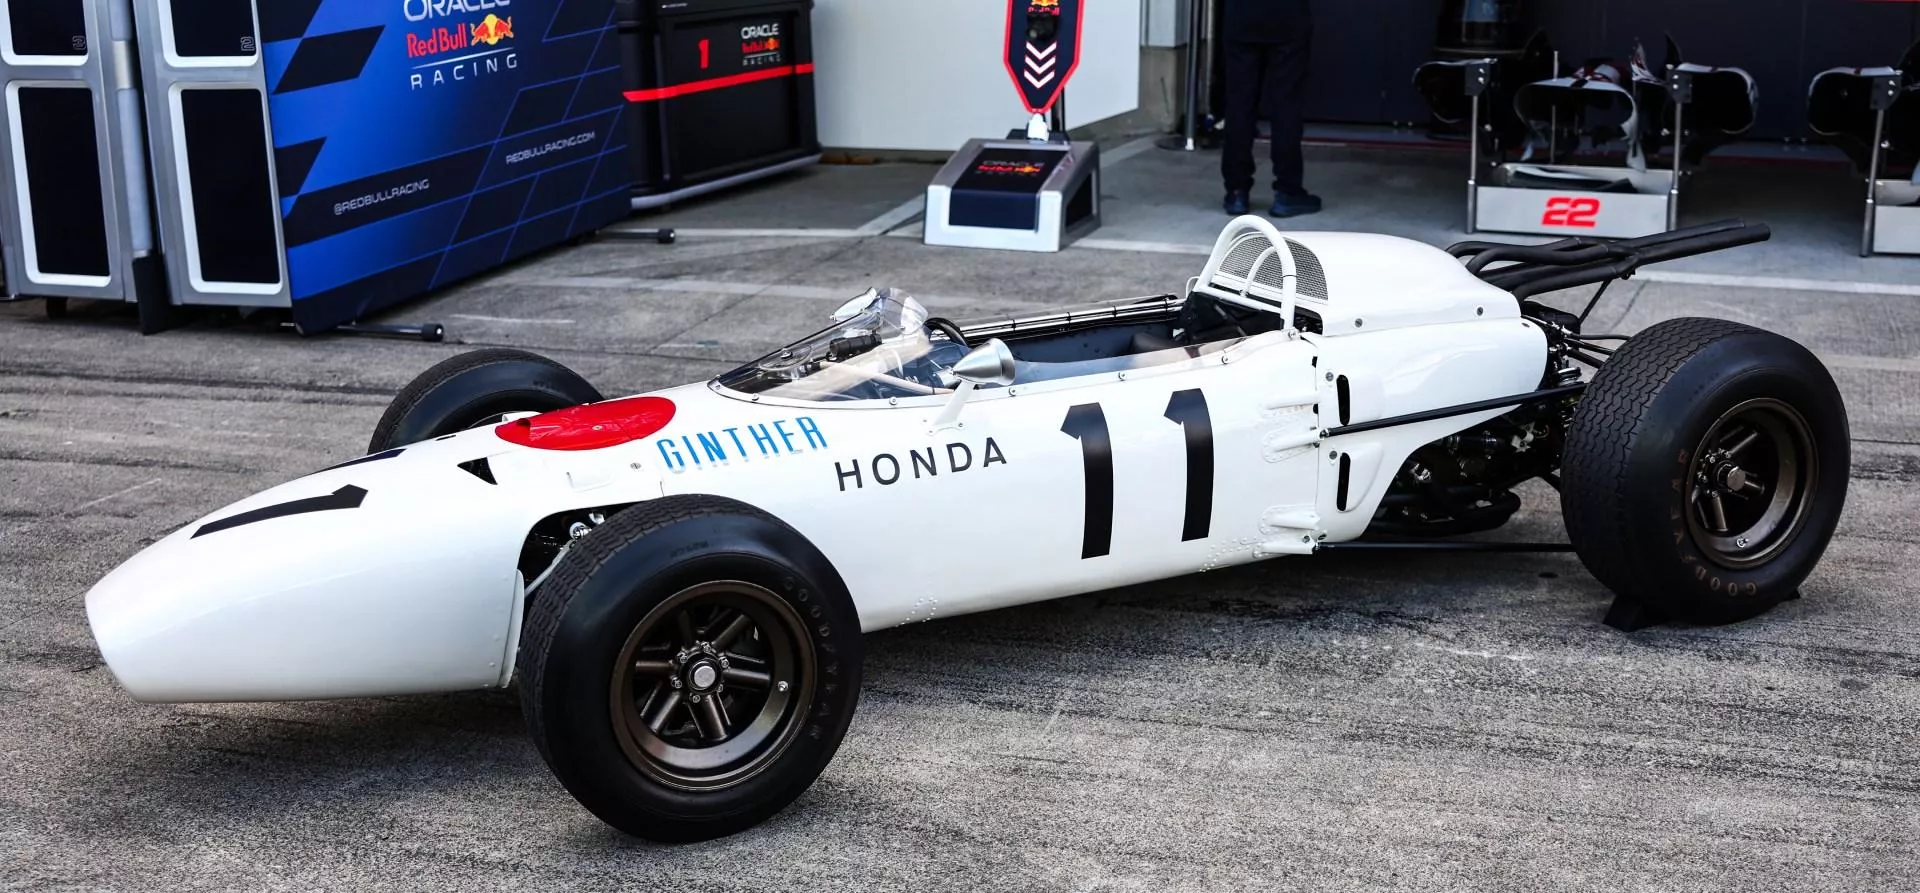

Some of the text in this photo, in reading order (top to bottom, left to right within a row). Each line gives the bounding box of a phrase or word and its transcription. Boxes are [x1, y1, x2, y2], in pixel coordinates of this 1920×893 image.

[404, 0, 511, 21] ORA
[240, 36, 255, 51] 2
[741, 23, 779, 39] ORACLE
[698, 38, 710, 69] 1
[411, 53, 517, 90] RACING
[506, 132, 596, 164] REDBULLRACING.COM
[334, 179, 430, 215] @REDBULLRACING
[1542, 197, 1600, 227] 22
[656, 416, 828, 474] GINTHER
[834, 436, 1007, 492] HONDA
[1060, 388, 1214, 559] 11
